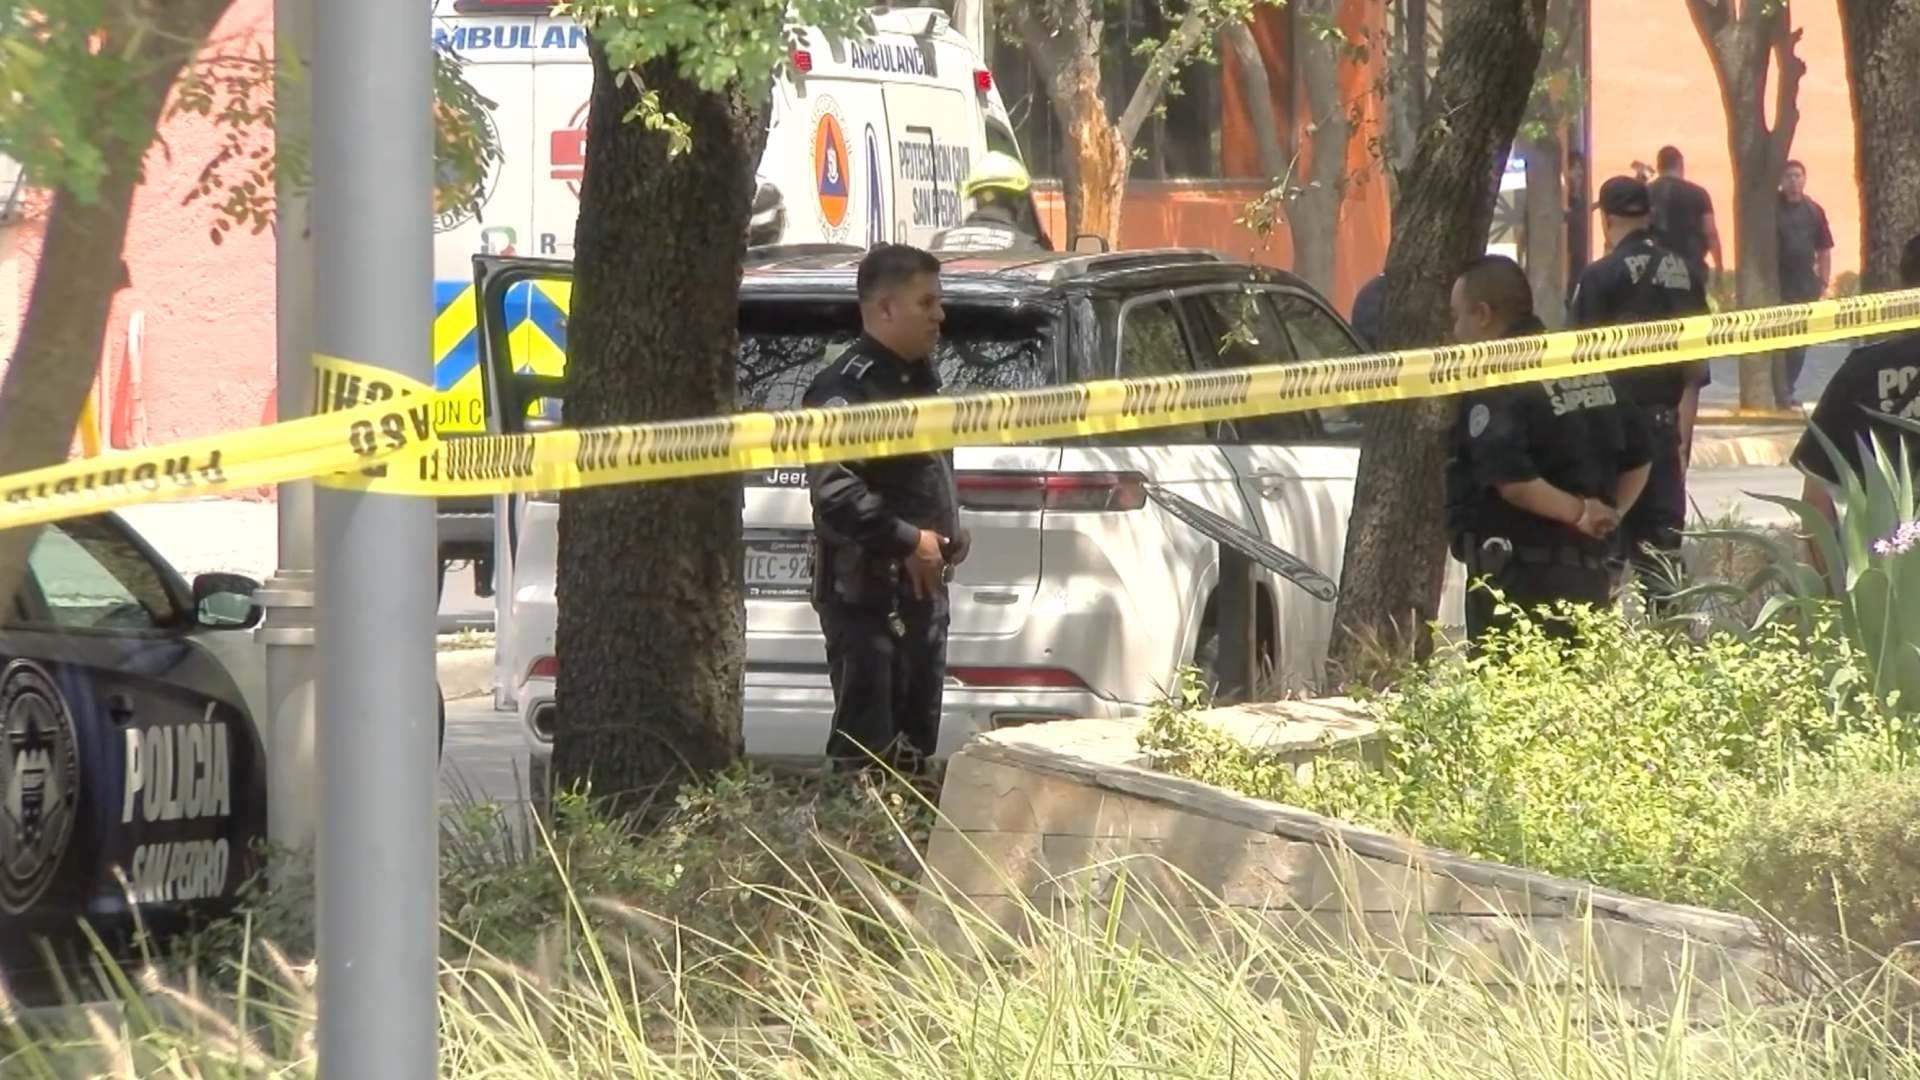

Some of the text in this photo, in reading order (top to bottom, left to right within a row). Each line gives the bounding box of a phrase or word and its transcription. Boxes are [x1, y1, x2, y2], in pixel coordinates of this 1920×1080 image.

[433, 25, 587, 50] MBULAN
[745, 555, 809, 580] TEC-92
[122, 701, 230, 823] POLICÍA
